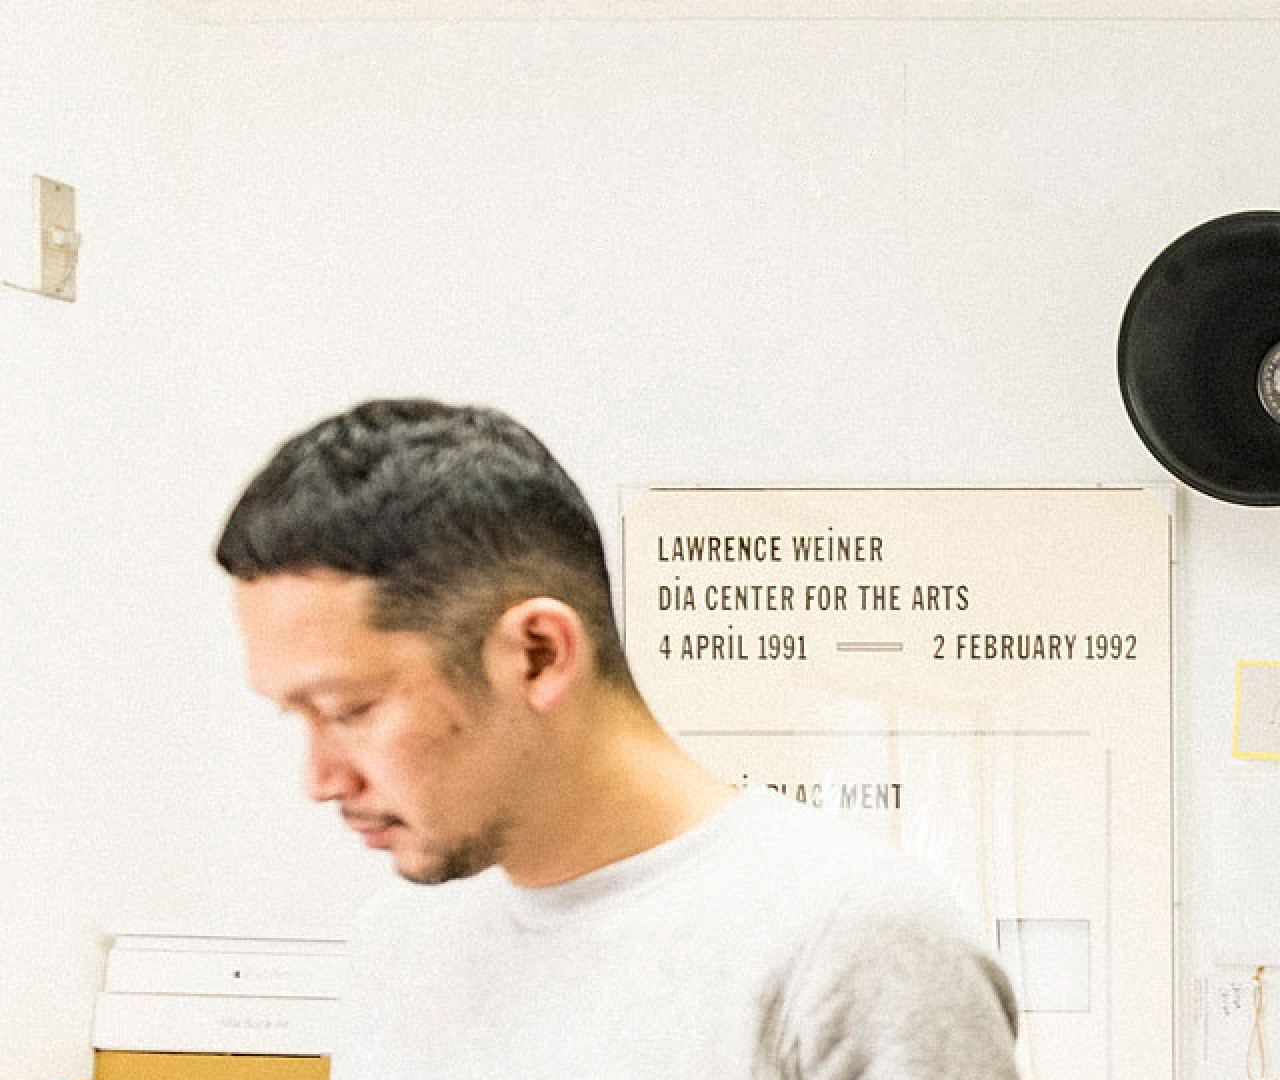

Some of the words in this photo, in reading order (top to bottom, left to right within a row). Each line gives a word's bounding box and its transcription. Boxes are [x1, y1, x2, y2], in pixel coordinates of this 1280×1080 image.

[657, 535, 783, 563] LAWRENCE
[705, 585, 795, 611] CENTER
[805, 585, 848, 611] FOR
[857, 585, 901, 611] THE
[911, 584, 970, 611] ARTS
[658, 633, 673, 661] 4
[757, 633, 808, 661] 1991
[932, 633, 946, 661] 2
[956, 633, 1077, 661] FEBRUARY
[1085, 633, 1138, 661] 1992
